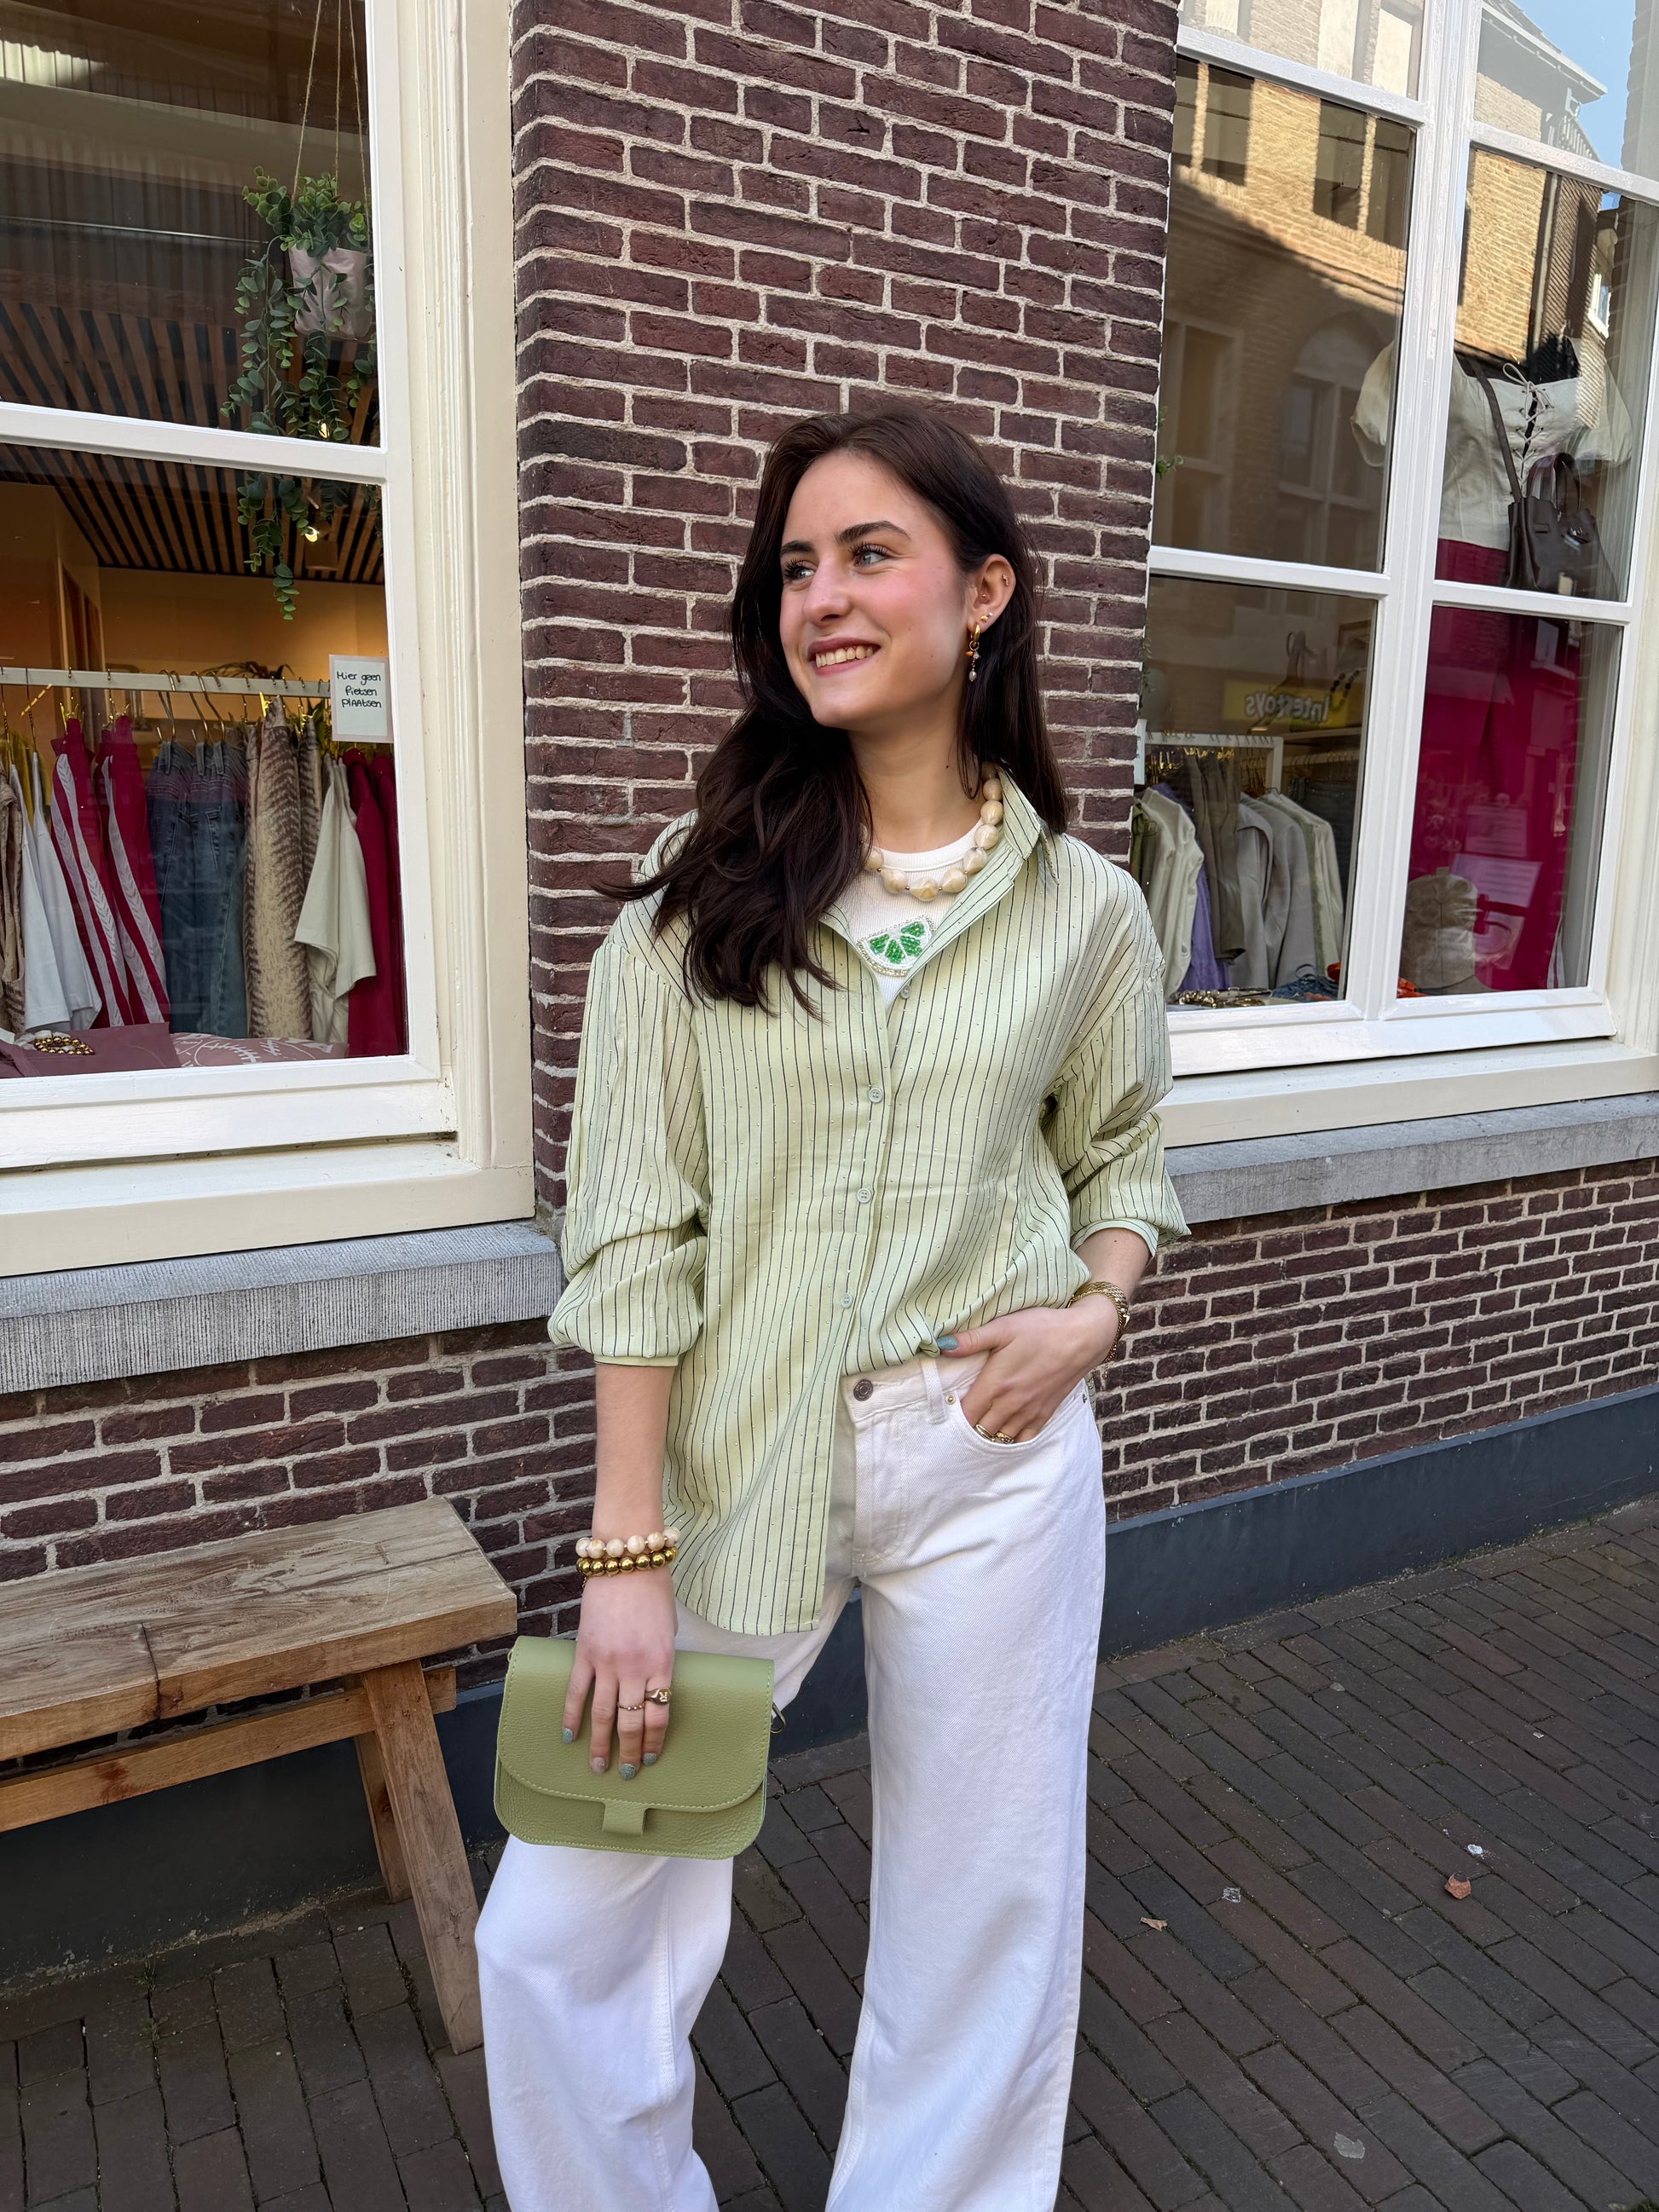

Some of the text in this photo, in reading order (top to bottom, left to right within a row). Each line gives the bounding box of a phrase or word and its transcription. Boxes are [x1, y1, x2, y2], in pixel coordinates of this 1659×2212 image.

[336, 671, 381, 685] Hier geen
[345, 685, 377, 696] fietsen
